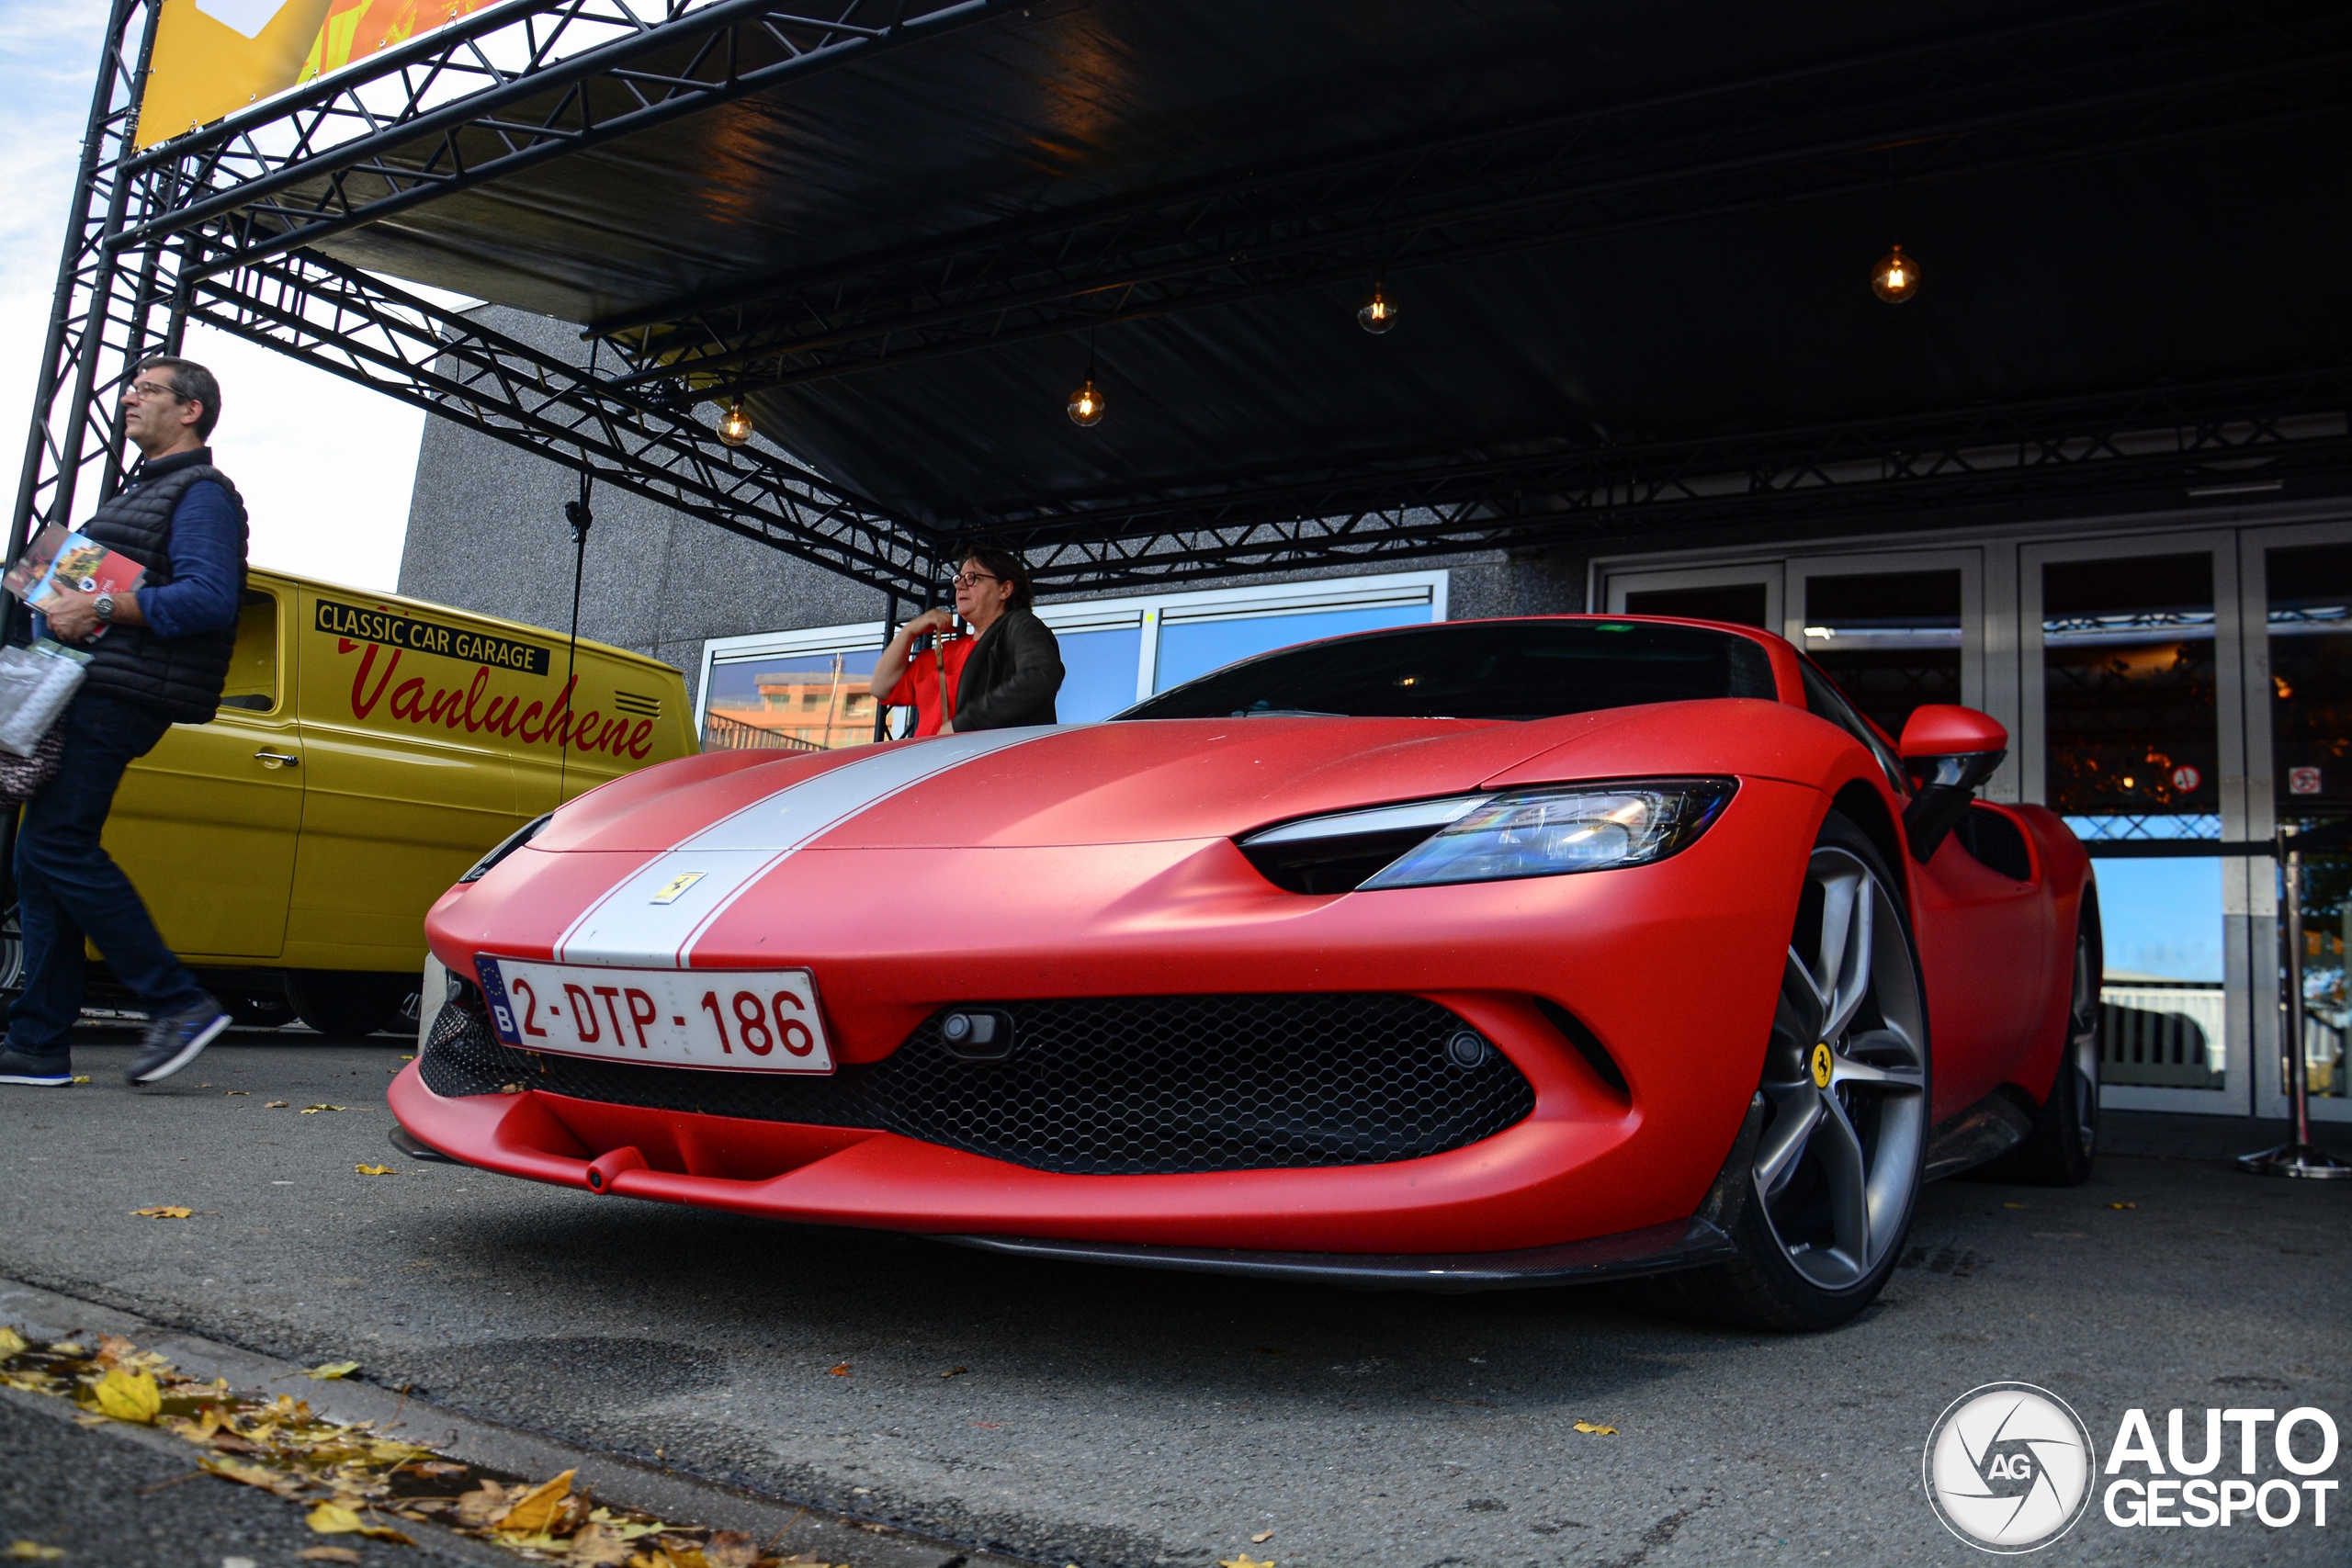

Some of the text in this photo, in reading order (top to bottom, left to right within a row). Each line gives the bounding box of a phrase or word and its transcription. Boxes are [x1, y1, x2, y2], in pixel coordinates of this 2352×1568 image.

[318, 604, 536, 671] CLASSIC CAR GARAGE
[338, 608, 653, 761] Vanluchene
[494, 1005, 514, 1032] B
